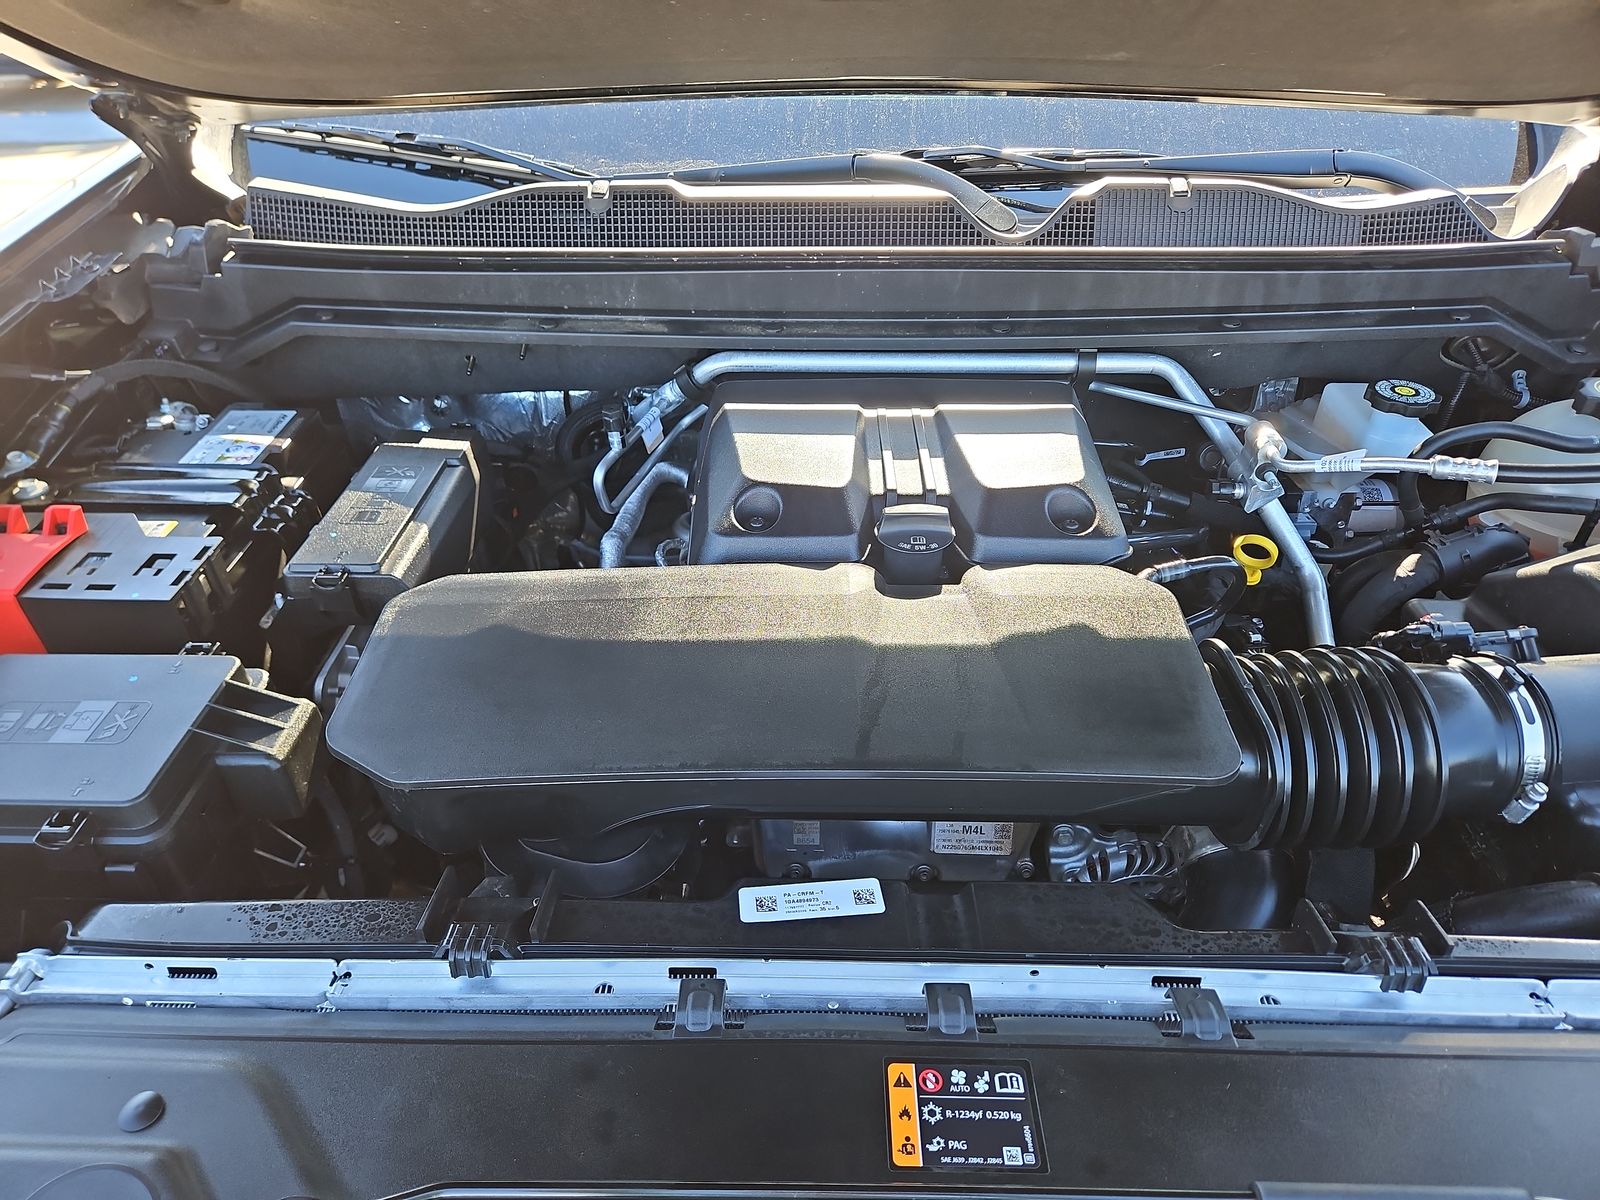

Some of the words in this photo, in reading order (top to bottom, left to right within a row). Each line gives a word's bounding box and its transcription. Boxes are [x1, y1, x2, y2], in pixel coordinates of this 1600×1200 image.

[962, 825, 986, 834] M4L
[946, 1110, 983, 1120] R-1234yf
[986, 1110, 1009, 1119] 0.520
[1010, 1110, 1022, 1122] kg
[948, 1140, 968, 1150] PAG
